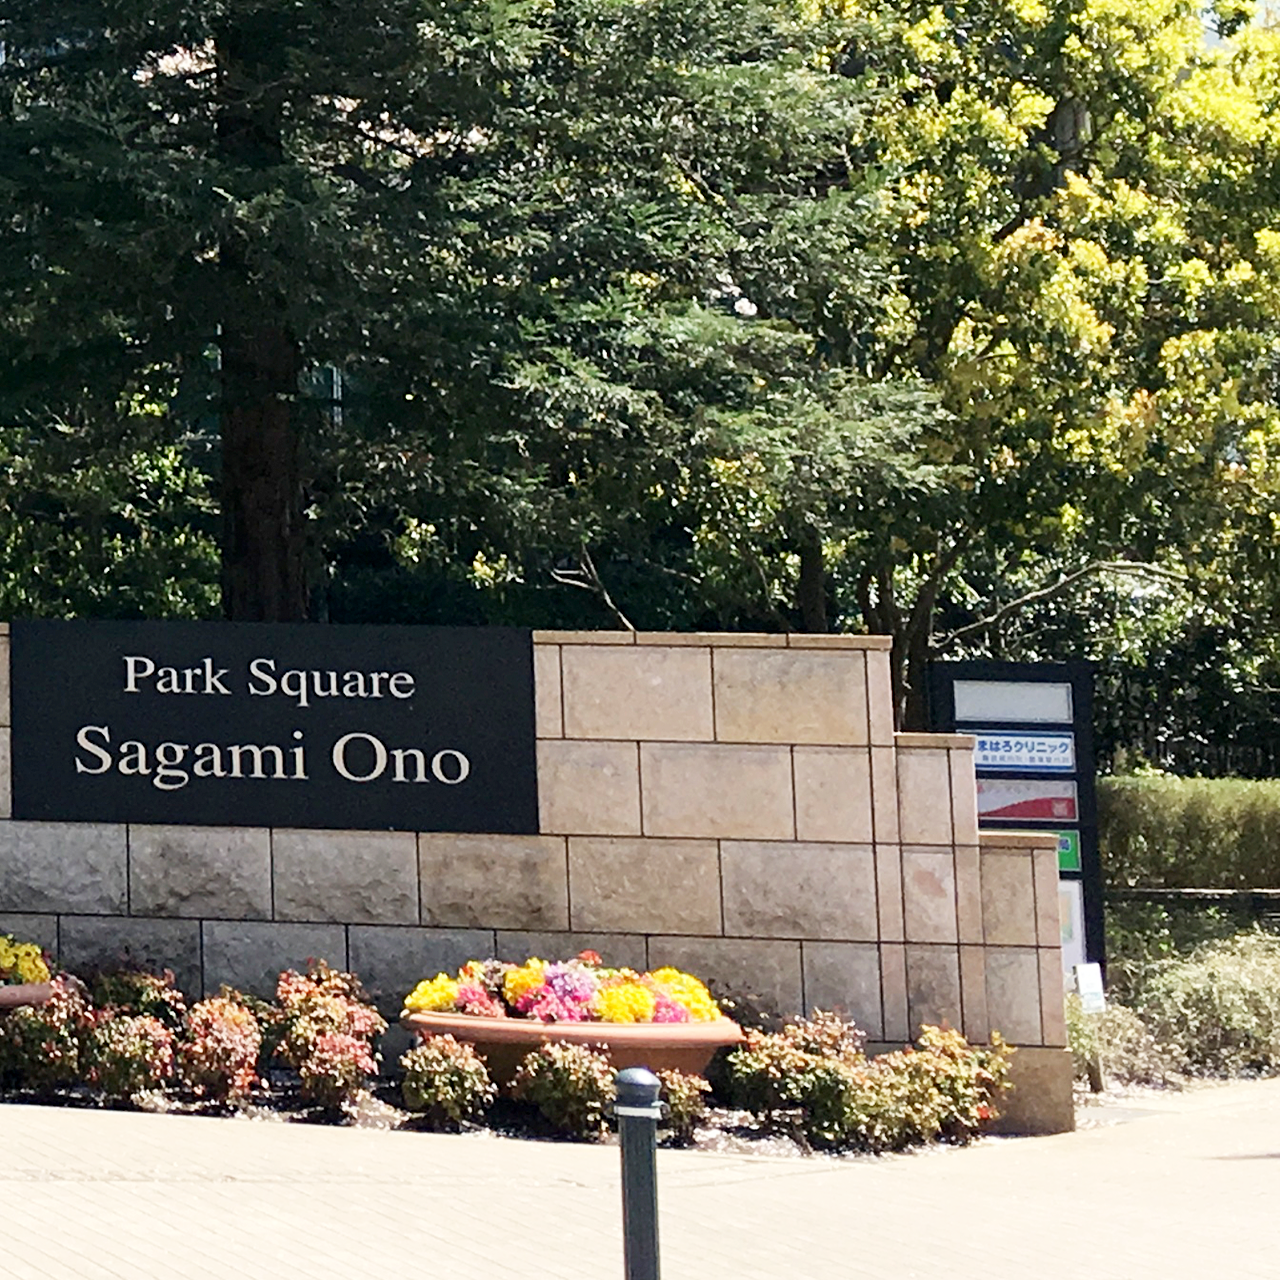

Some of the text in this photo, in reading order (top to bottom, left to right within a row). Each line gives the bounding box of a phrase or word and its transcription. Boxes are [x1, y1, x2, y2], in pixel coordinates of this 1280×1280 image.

[123, 657, 416, 707] Park Square
[74, 725, 471, 790] Sagami Ono
